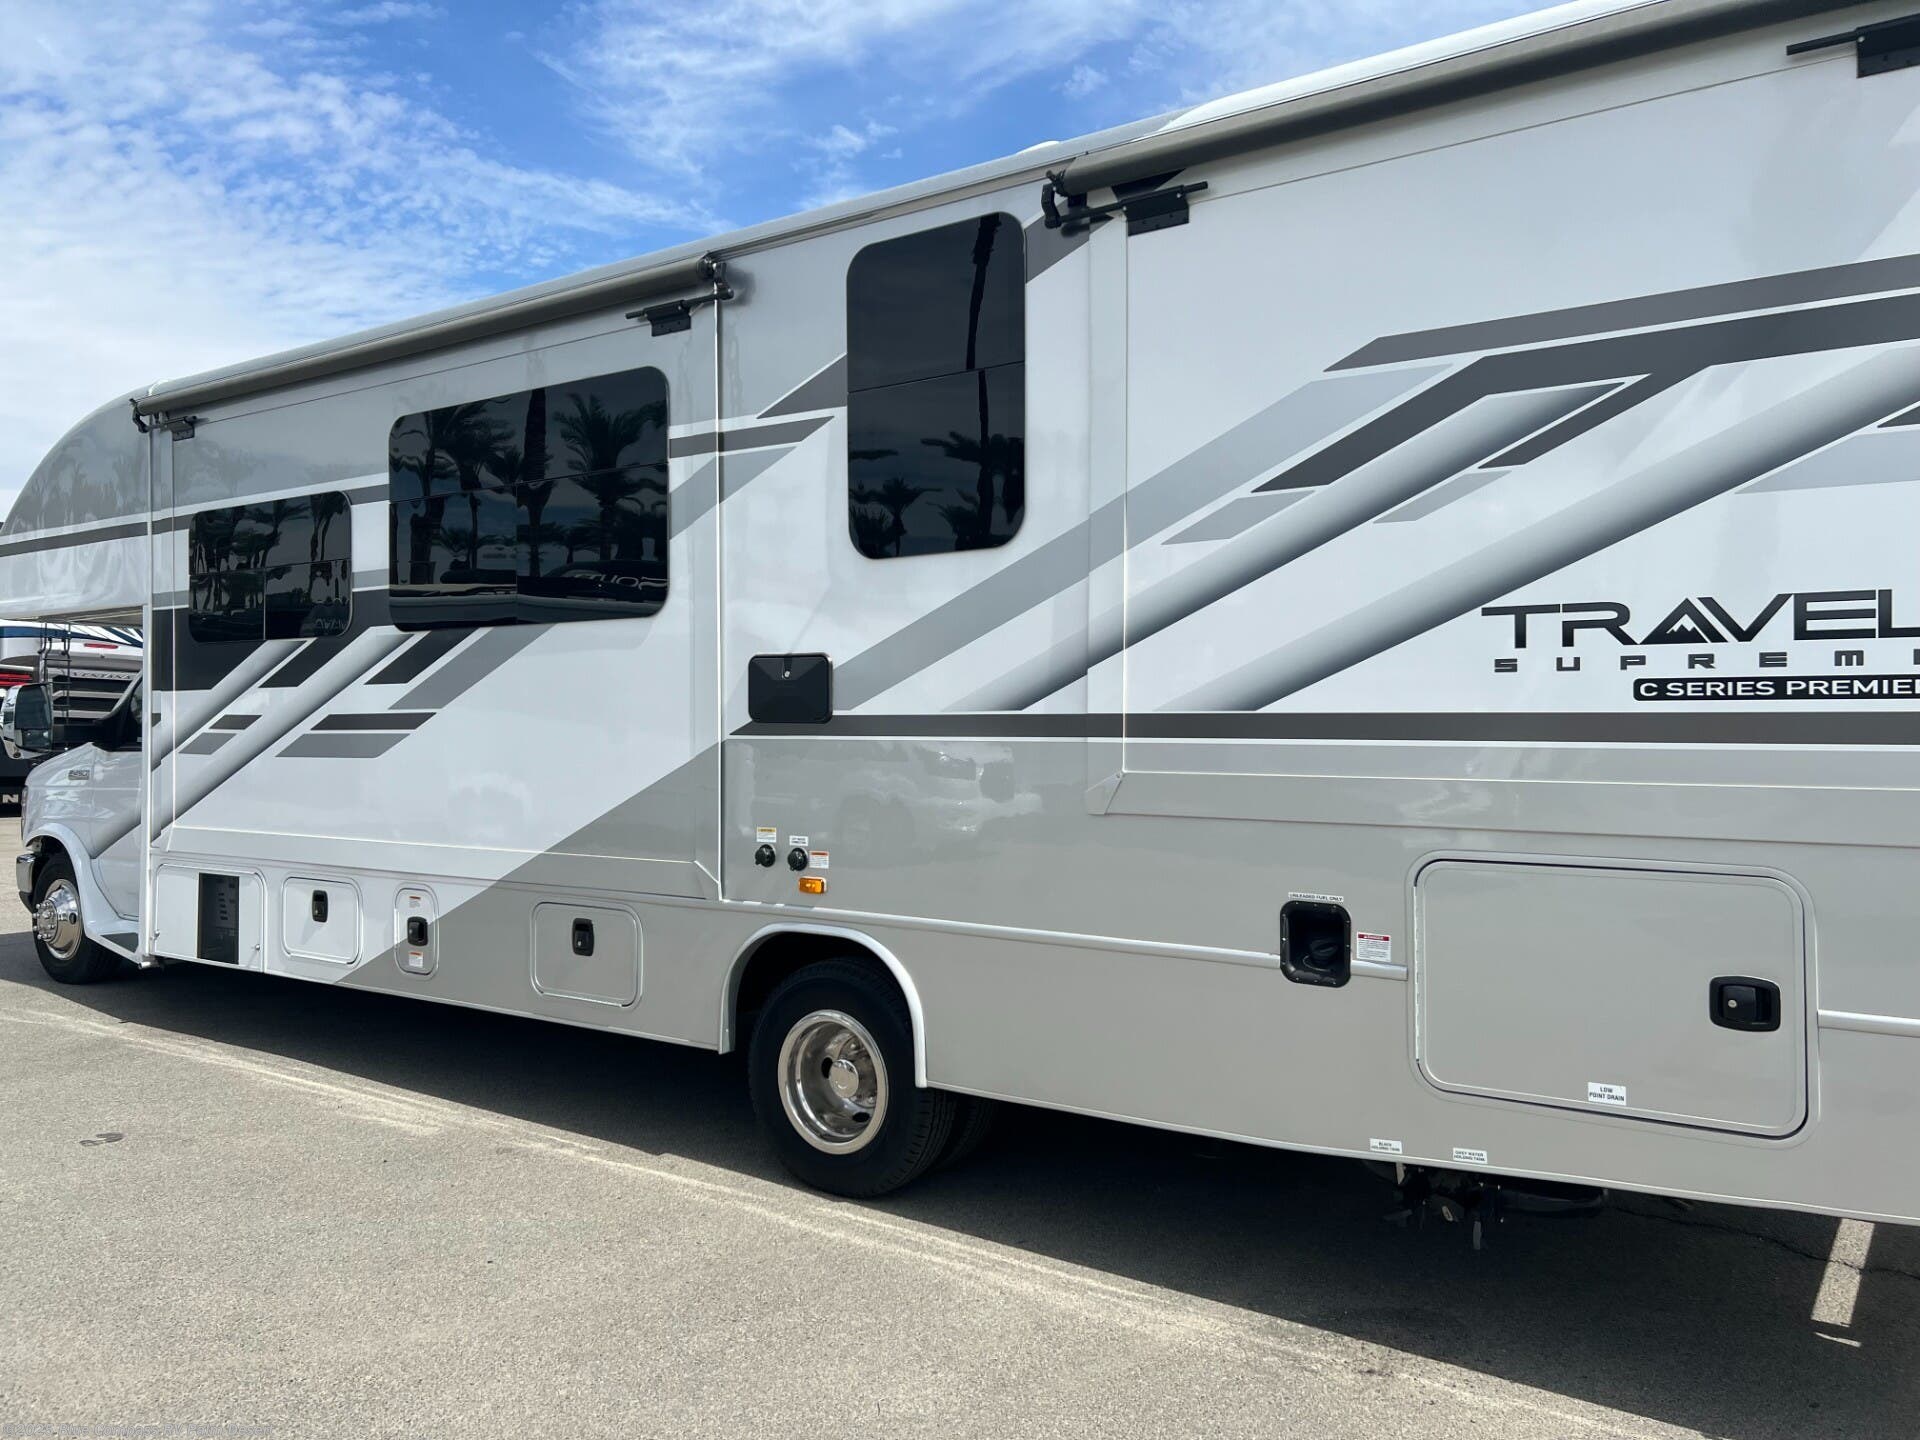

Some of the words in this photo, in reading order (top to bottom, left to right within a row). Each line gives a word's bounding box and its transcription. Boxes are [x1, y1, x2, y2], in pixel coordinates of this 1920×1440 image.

[1481, 588, 1920, 648] TRAVEL
[1494, 649, 1920, 673] SUPREM
[1639, 683, 1658, 697] C
[1665, 681, 1775, 697] SERIES
[1786, 679, 1920, 696] PREMIE
